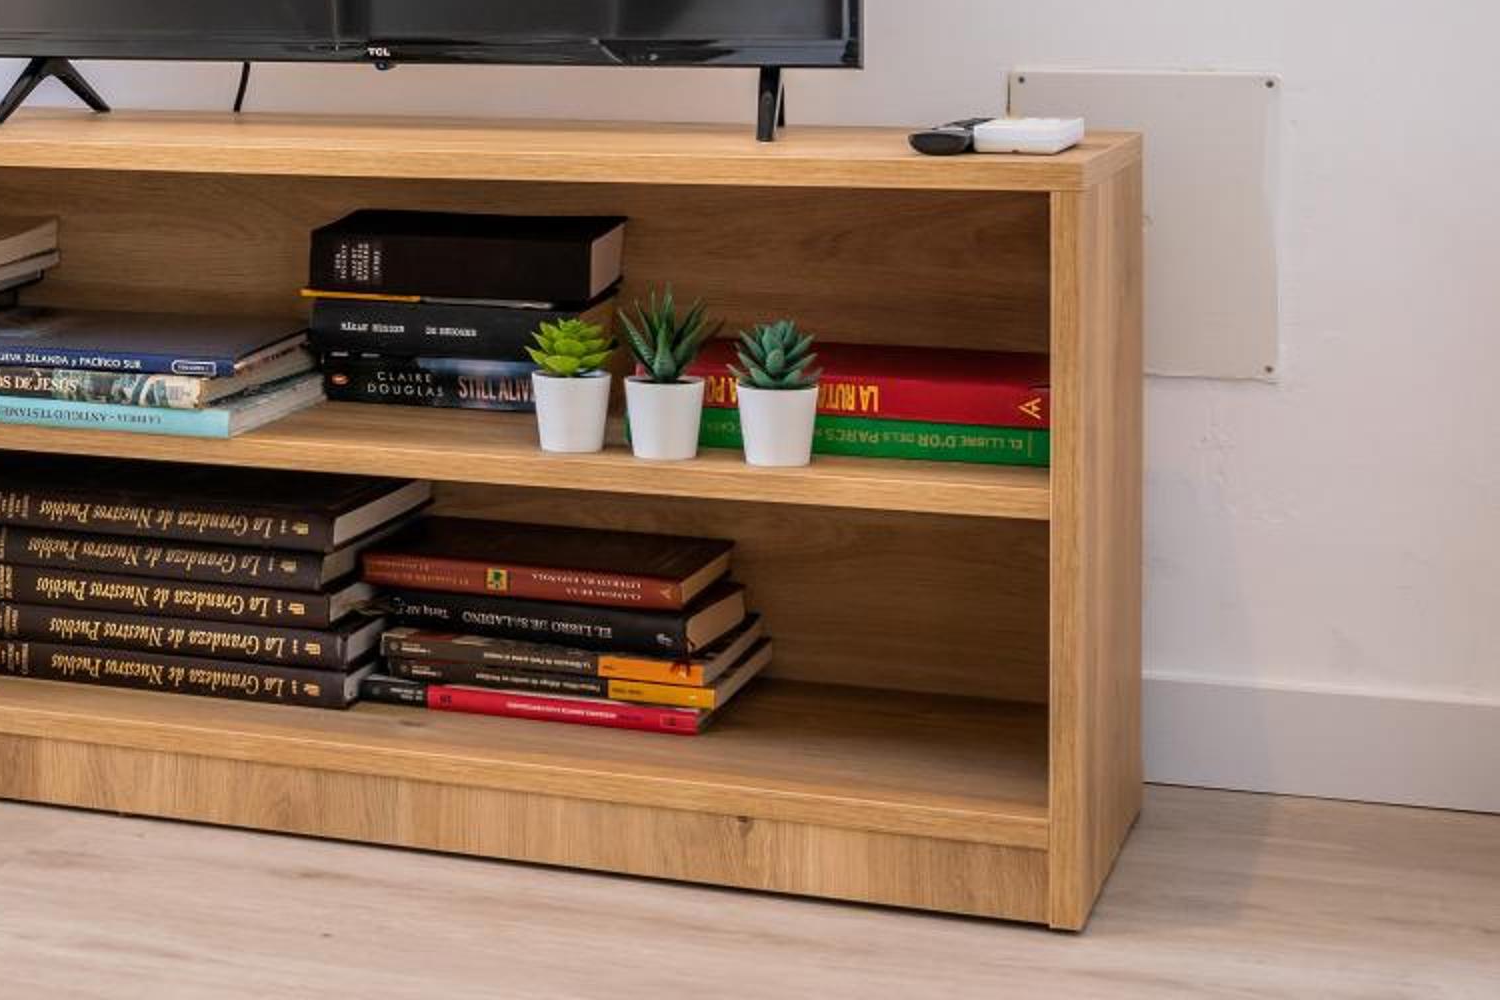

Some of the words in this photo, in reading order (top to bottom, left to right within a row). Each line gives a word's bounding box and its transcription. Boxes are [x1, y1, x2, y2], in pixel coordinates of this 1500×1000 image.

[367, 46, 391, 57] TCL
[25, 353, 69, 366] ZELANDA
[123, 359, 143, 370] SUR
[14, 375, 33, 391] DE
[377, 370, 434, 384] CLAIRE
[367, 381, 445, 398] DOUGLAS
[457, 375, 495, 401] STILL
[499, 376, 535, 403] ALIV
[859, 384, 879, 413] LA
[827, 428, 879, 444] PARCS
[918, 433, 957, 448] D'OR
[1011, 438, 1023, 449] EL
[39, 499, 91, 523] Pueblos
[93, 504, 153, 529] Nuestros
[156, 508, 174, 531] de
[177, 510, 249, 537] Grandeza
[252, 516, 274, 539] La
[27, 537, 79, 561] Pueblos
[80, 541, 143, 568] Nuestros
[144, 546, 164, 569] de
[165, 549, 237, 574] Grandeza
[240, 554, 262, 577] La
[35, 577, 88, 601] Pueblos
[89, 581, 150, 608] Nuestros
[152, 586, 171, 610] de
[173, 588, 245, 615] Grandeza
[249, 596, 272, 618] La
[419, 603, 451, 619] Tariq
[48, 617, 102, 641] Pueblos
[103, 621, 165, 648] Nuestros
[167, 627, 186, 650] de
[550, 620, 593, 637] LIBRO
[594, 624, 613, 639] EL
[187, 629, 260, 656] Grandeza
[264, 636, 287, 659] La
[51, 653, 103, 679] Pueblos
[104, 658, 166, 686] Nuestros
[167, 665, 186, 688] de
[188, 667, 260, 696] Grandeza
[263, 676, 286, 698] La
